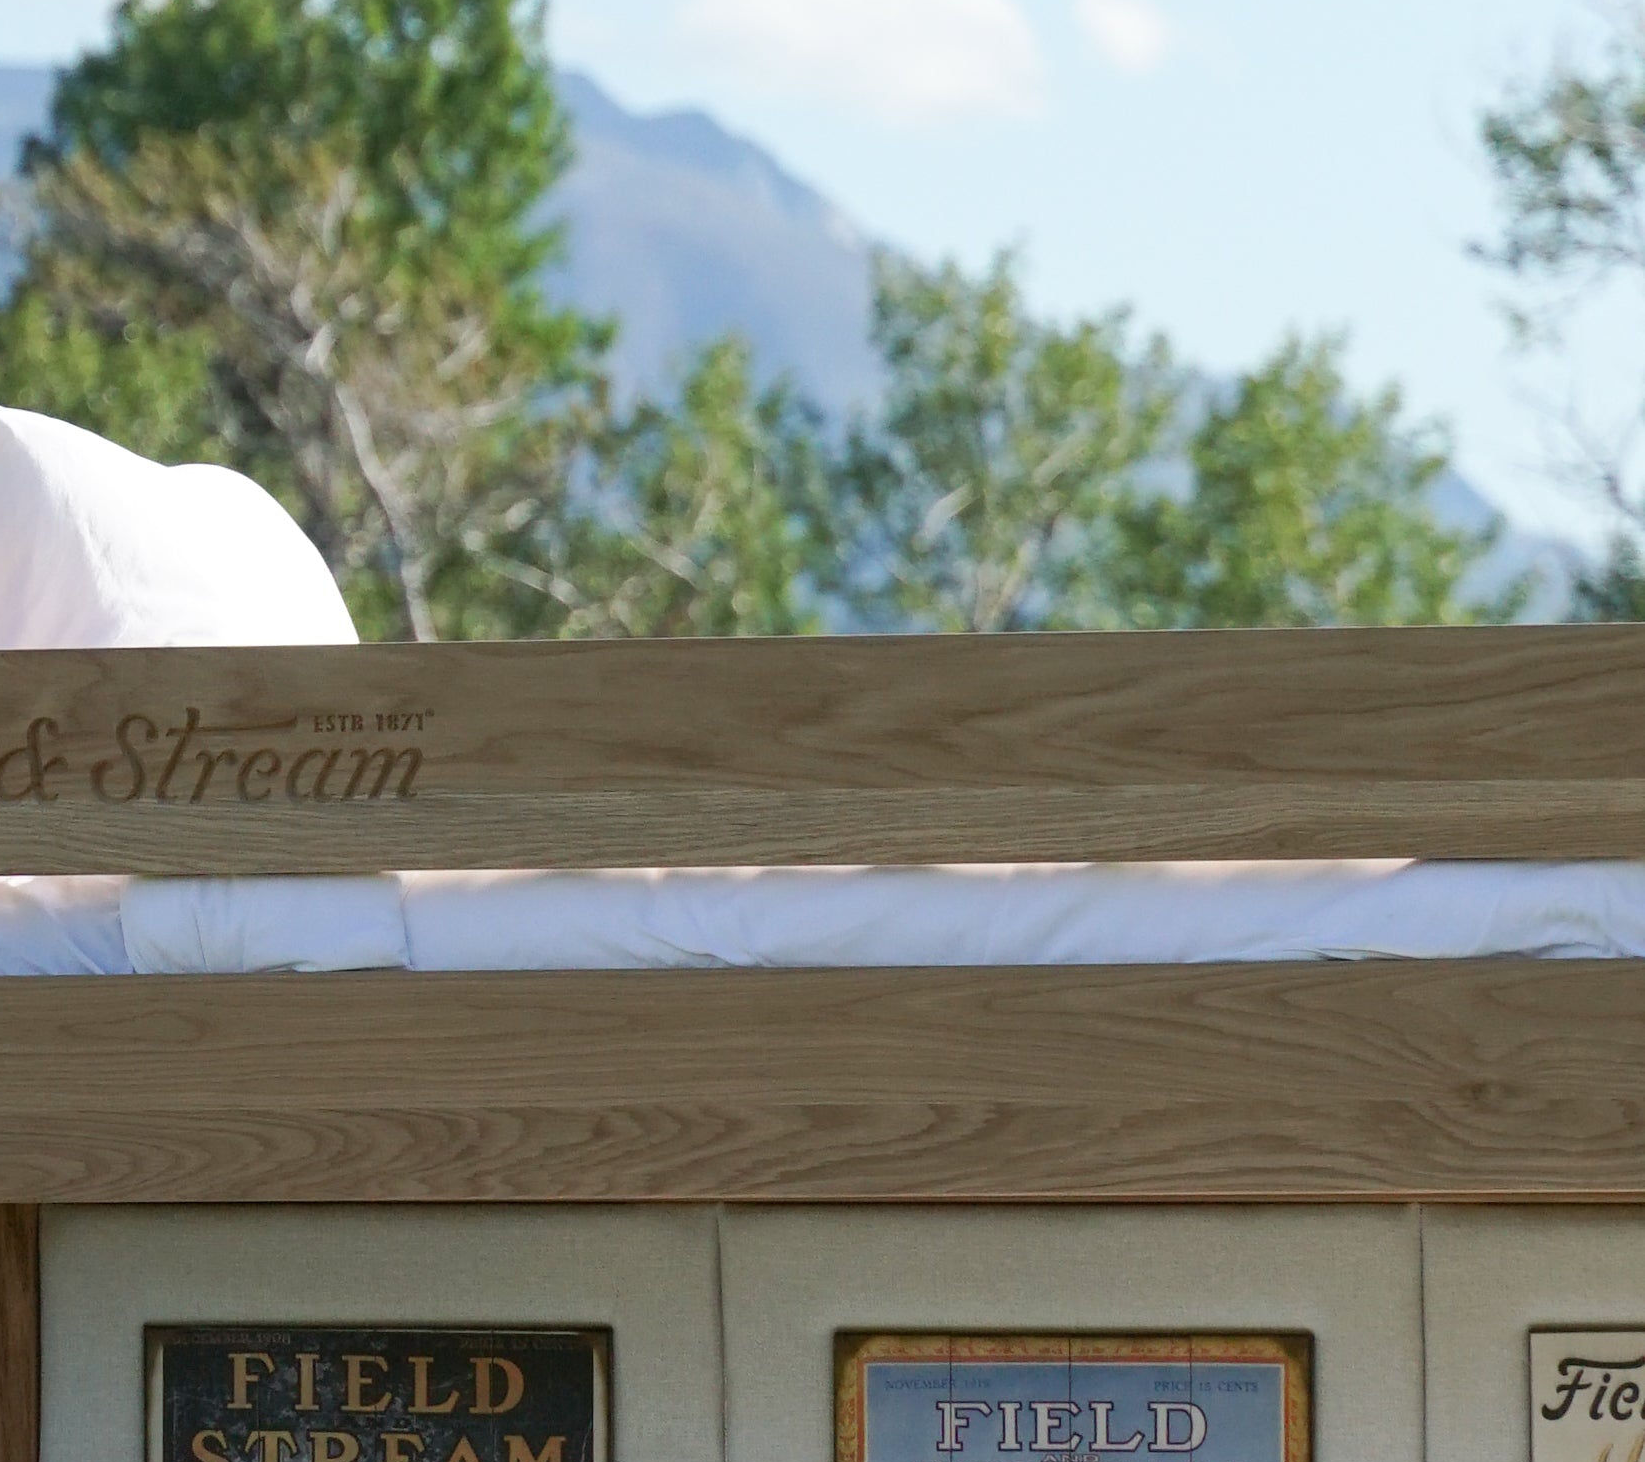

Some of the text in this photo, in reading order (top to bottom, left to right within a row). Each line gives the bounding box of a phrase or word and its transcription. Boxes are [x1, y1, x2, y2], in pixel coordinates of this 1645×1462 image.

[90, 706, 424, 805] Stream
[226, 1352, 525, 1415] FIELD
[884, 1378, 956, 1390] NOVEMBER
[1154, 1380, 1192, 1392] PRICE
[1218, 1381, 1259, 1392] CENTS
[1541, 1355, 1645, 1421] Fie
[936, 1400, 1208, 1452] FIELD
